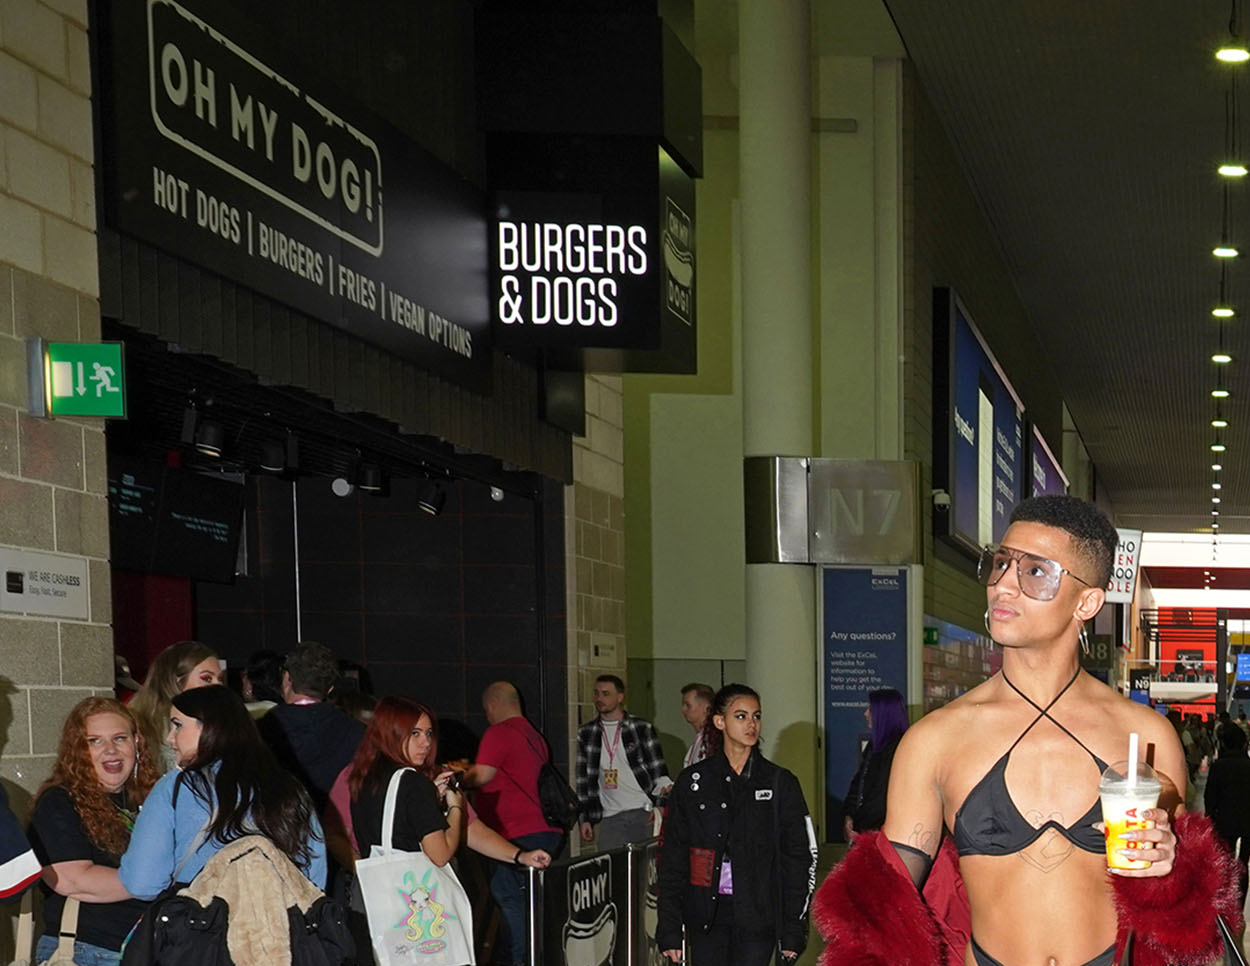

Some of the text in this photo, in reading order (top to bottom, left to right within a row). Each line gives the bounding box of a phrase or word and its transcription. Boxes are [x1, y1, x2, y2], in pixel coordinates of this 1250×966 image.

[161, 43, 373, 223] OH MY DOG!
[153, 166, 473, 360] HOT DOGS BURGERS FRIES VEGAN OPTIONS
[498, 221, 648, 276] BURGERS
[498, 274, 618, 328] & DOGS
[826, 487, 902, 537] N7
[52, 573, 81, 587] CASHLESS
[830, 631, 897, 641] Any questions?
[1134, 679, 1150, 690] N9
[572, 877, 591, 913] OH
[591, 872, 608, 907] MY
